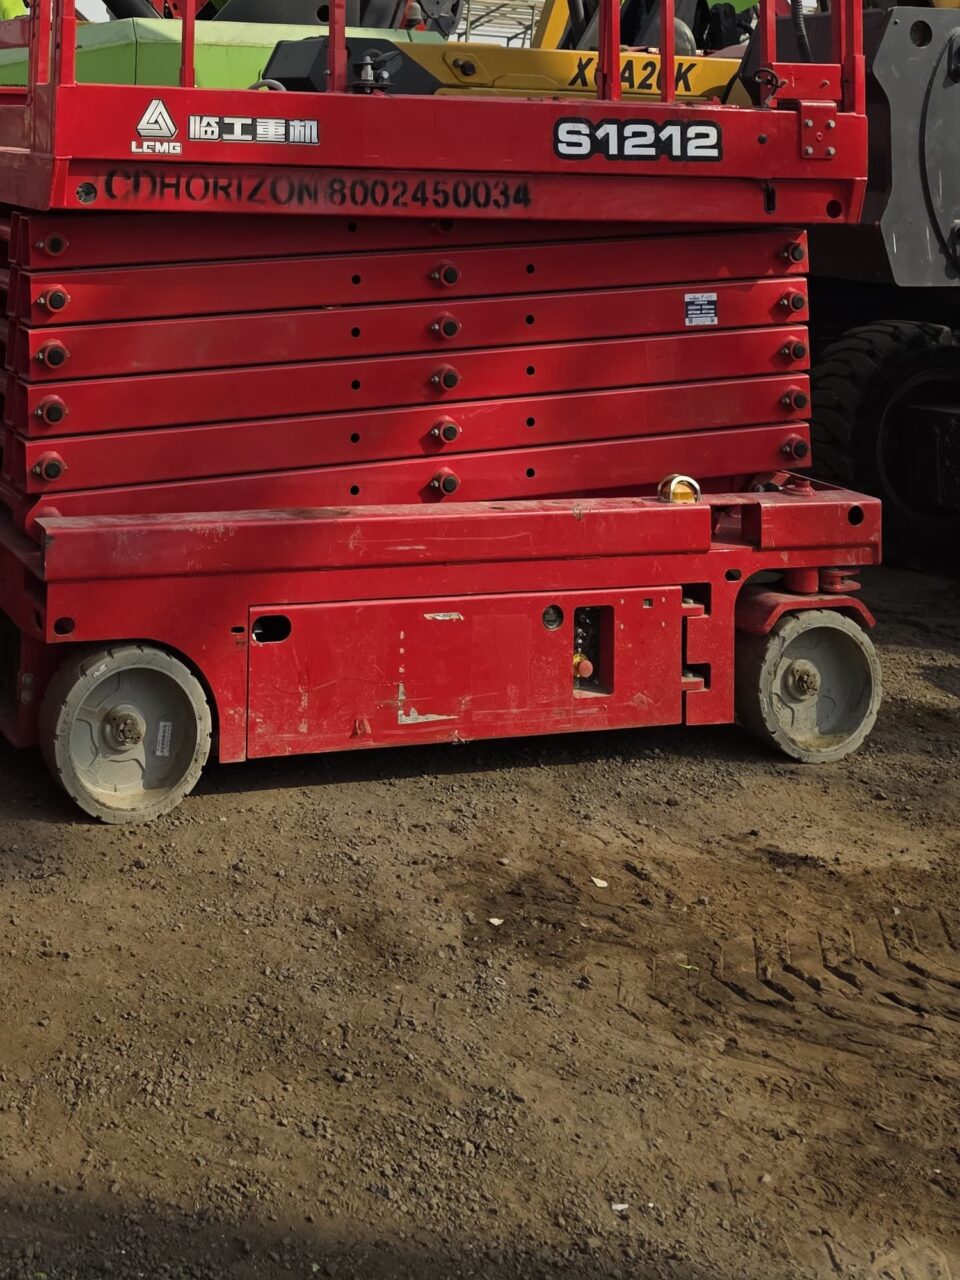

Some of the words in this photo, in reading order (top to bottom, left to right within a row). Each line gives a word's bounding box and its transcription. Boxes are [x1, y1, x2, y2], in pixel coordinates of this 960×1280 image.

[568, 56, 697, 92] XA2K
[188, 115, 319, 144] 临工重机
[556, 121, 720, 158] S1212
